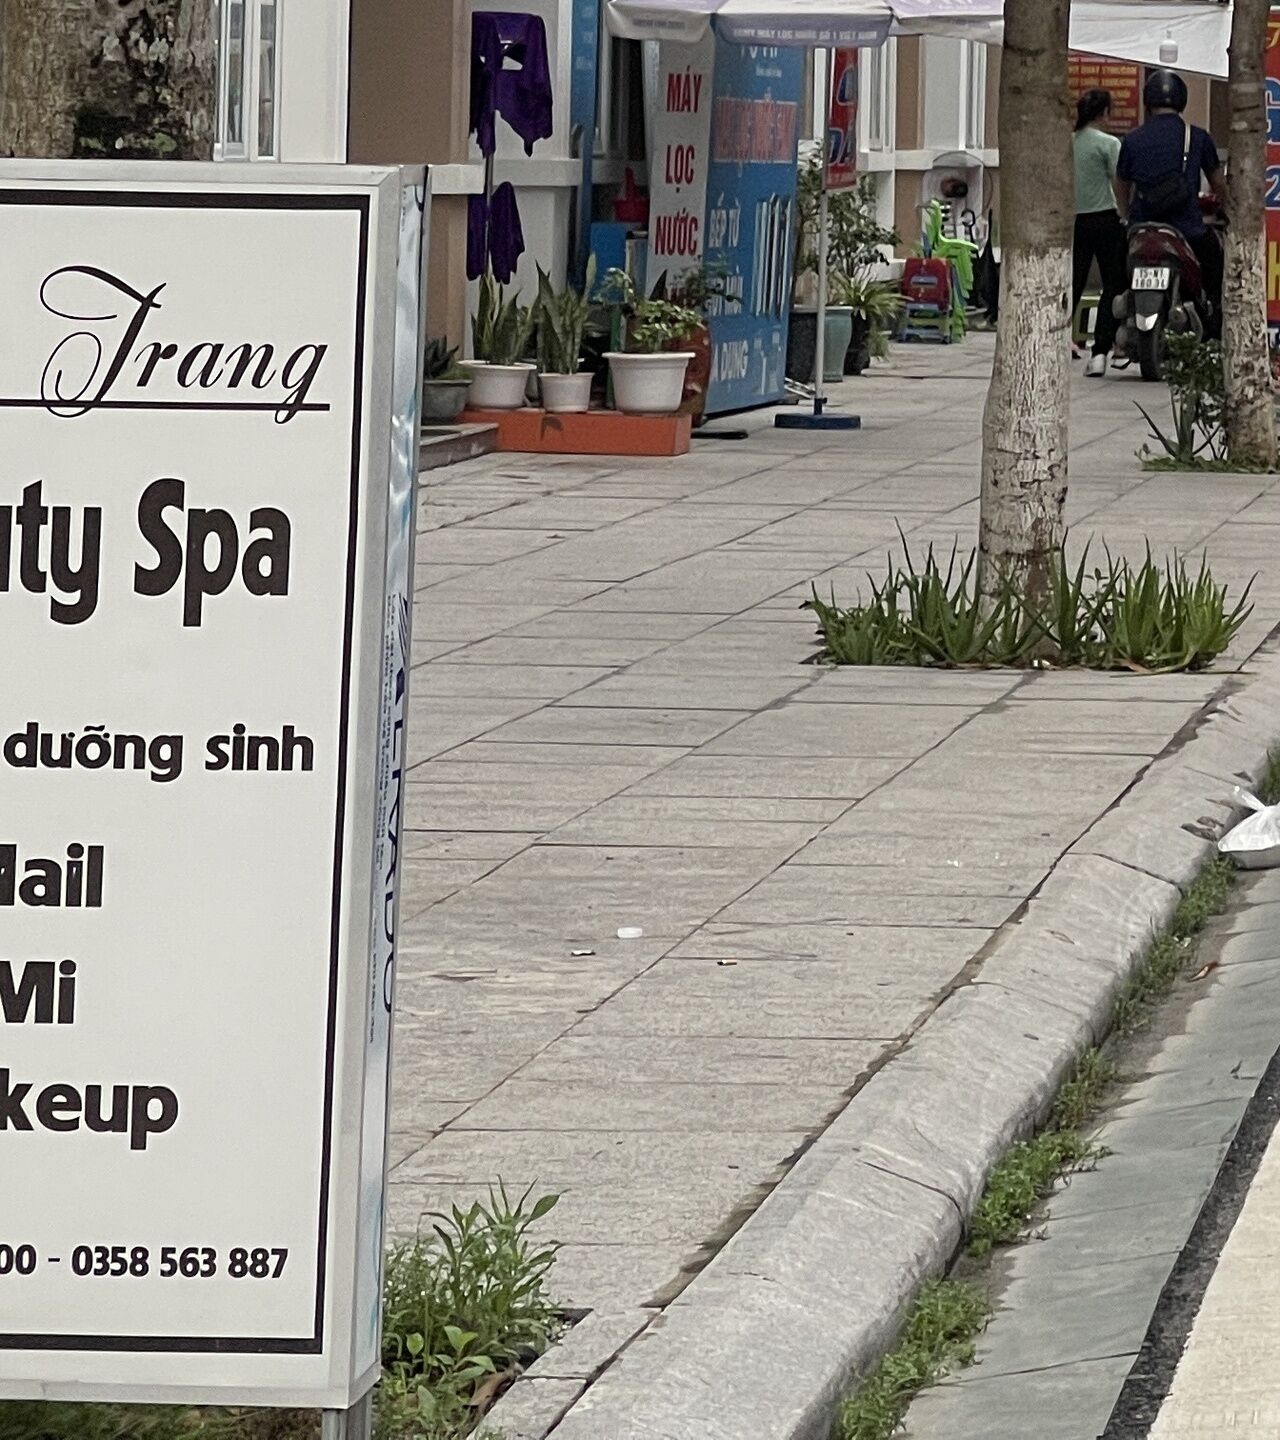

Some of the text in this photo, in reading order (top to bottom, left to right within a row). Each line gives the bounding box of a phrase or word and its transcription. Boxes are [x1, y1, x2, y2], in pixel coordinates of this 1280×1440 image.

[667, 65, 702, 112] MÁY
[665, 145, 695, 193] LỌC
[654, 208, 698, 256] NƯỚC
[40, 265, 328, 424] Trang
[134, 478, 291, 627] Spa
[3, 722, 314, 782] dưỡng sinh
[71, 1246, 149, 1277] 0358
[160, 1248, 217, 1278] 563
[228, 1248, 289, 1278] 887
